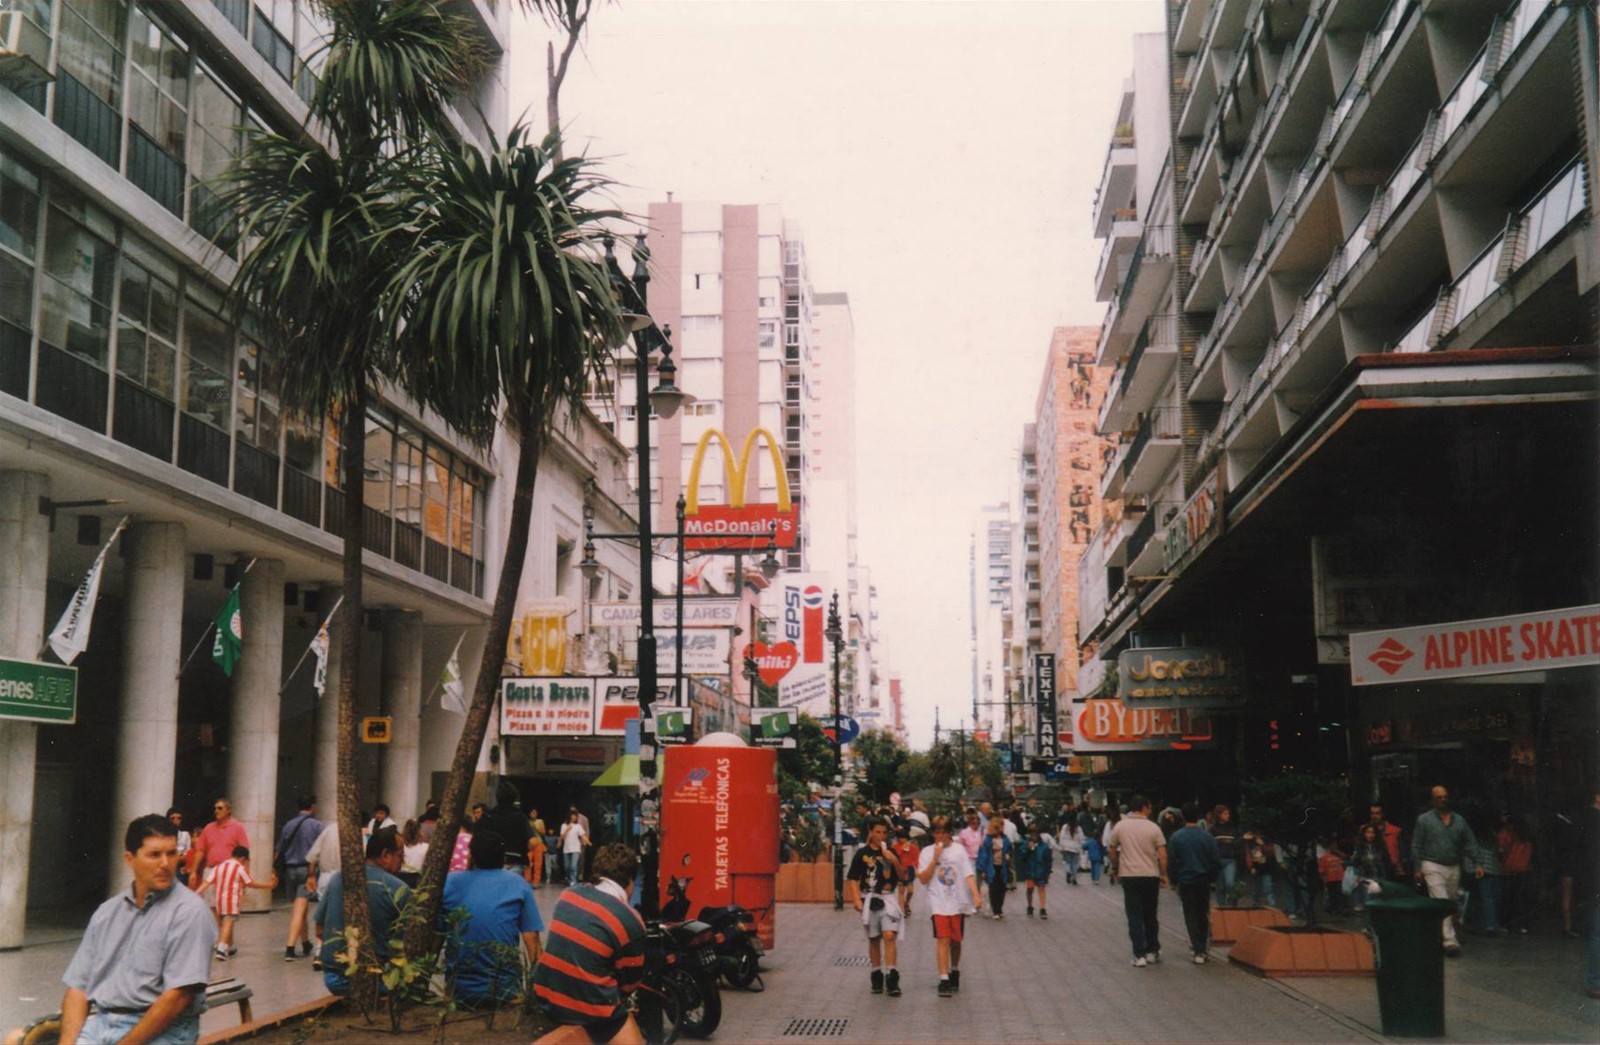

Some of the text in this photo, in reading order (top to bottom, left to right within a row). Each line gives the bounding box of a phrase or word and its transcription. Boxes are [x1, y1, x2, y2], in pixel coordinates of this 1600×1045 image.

[602, 607, 642, 620] CAMA
[785, 586, 800, 645] EPSI
[1424, 626, 1514, 671] ALPINE
[505, 682, 590, 701] Costa Brava
[605, 685, 677, 700] PESI
[505, 709, 533, 719] Pizza
[509, 722, 537, 731] Pizza
[715, 757, 730, 891] TARJETAS TELEFONICAS
